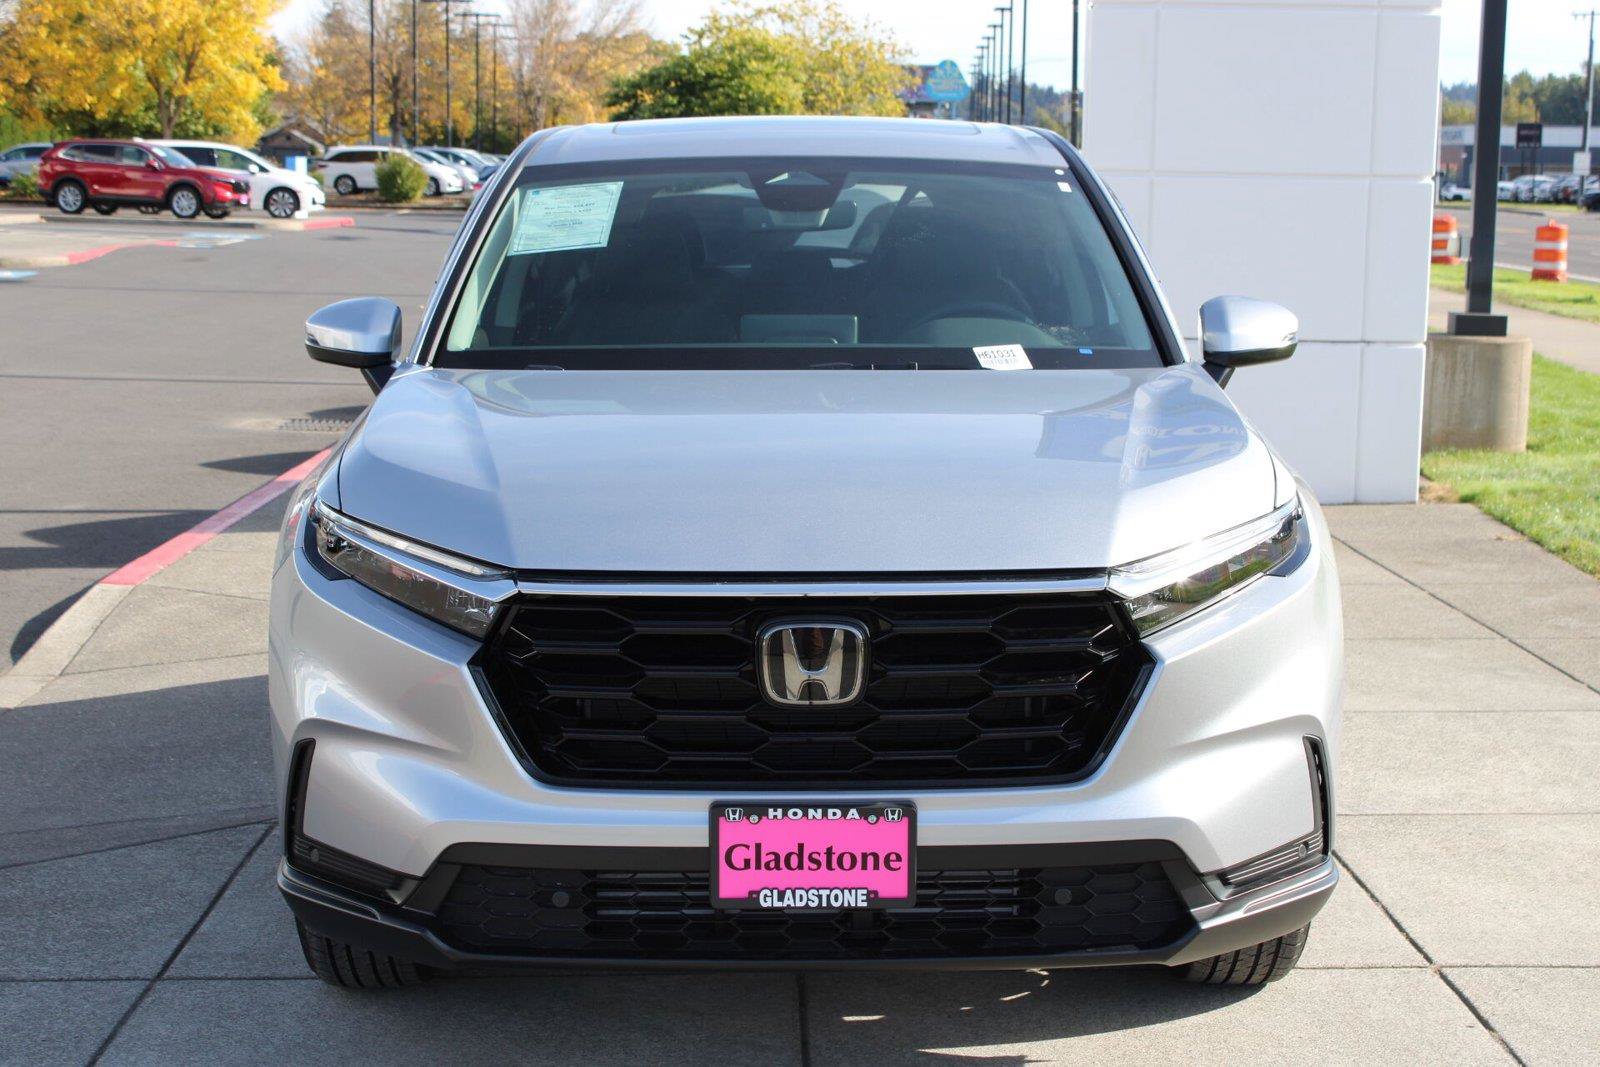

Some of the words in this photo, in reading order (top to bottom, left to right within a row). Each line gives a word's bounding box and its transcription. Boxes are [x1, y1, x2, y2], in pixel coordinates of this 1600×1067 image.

[977, 348, 1016, 359] H61031
[768, 808, 861, 820] HONDA
[724, 842, 903, 871] Gladstone
[759, 888, 868, 907] GLADSTONE
